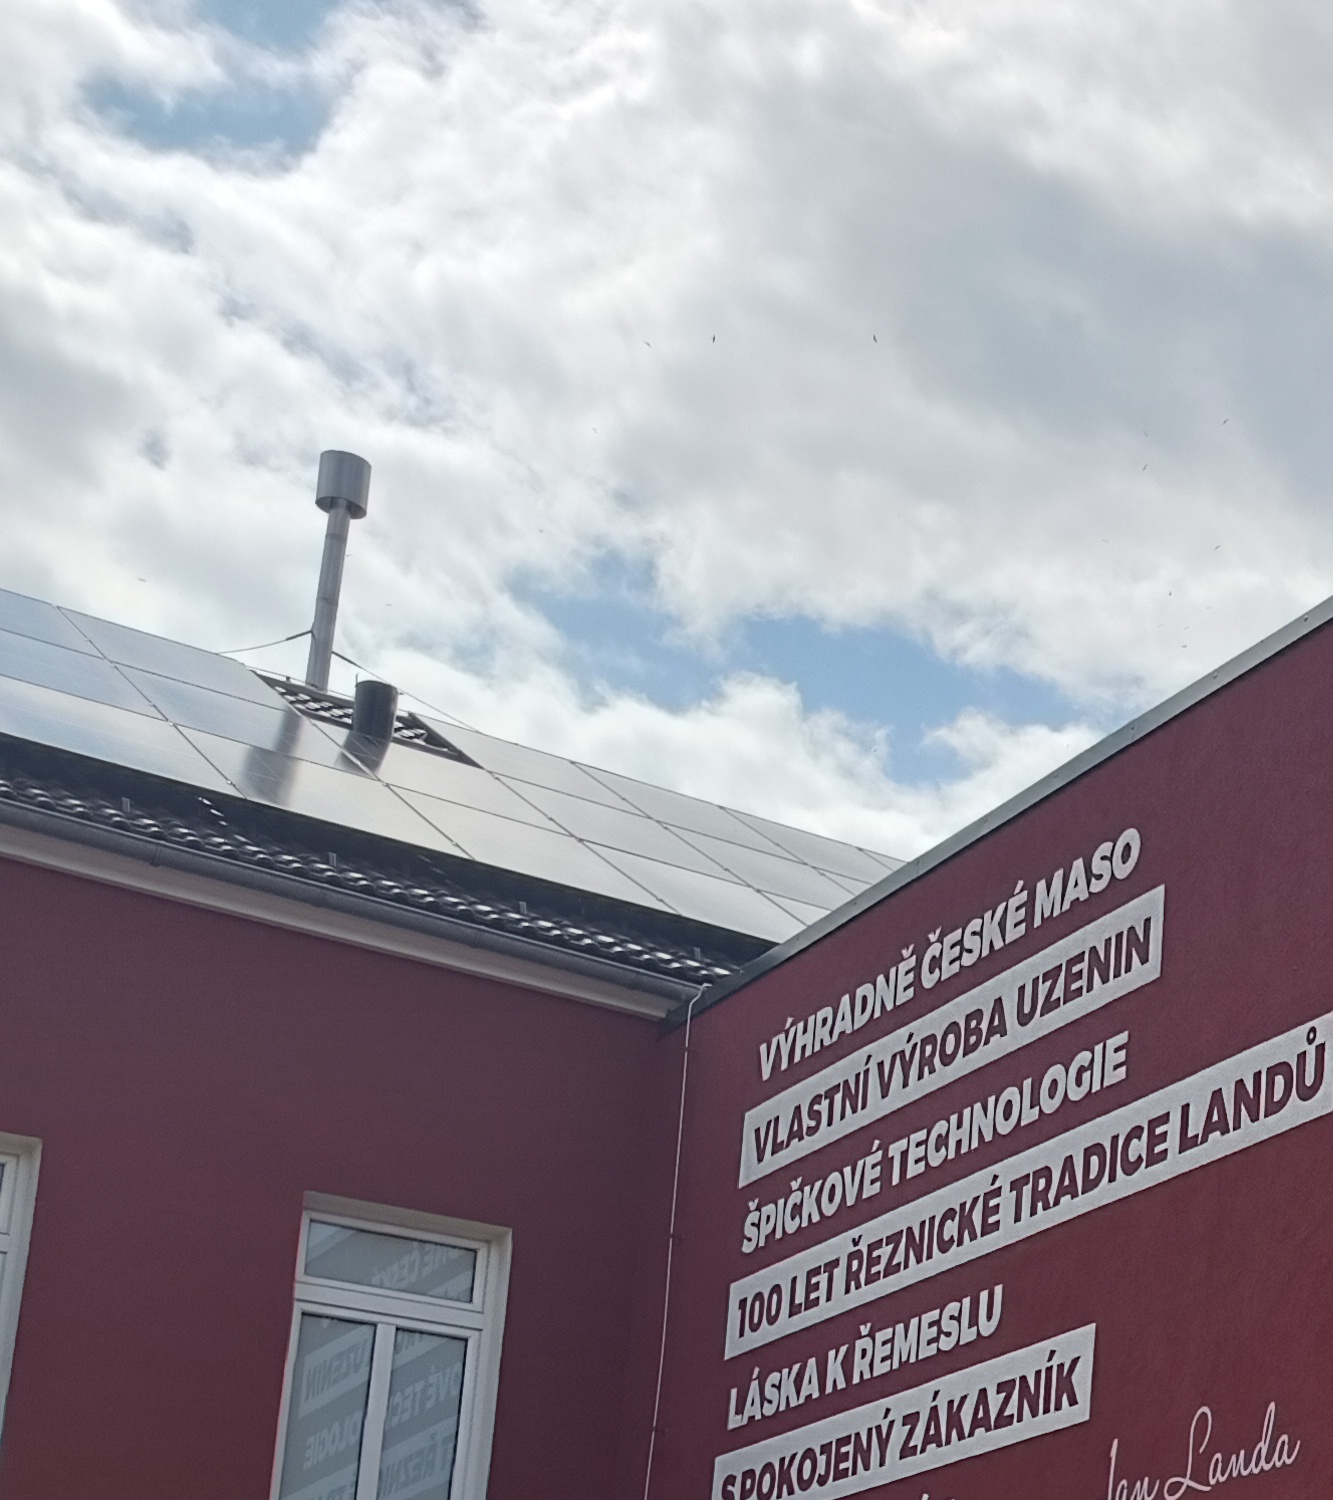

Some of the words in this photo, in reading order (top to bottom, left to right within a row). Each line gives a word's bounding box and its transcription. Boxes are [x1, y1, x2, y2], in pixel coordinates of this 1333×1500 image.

[752, 1055, 871, 1164] VLASTNÍ
[876, 996, 1008, 1099] VÝROBA
[1015, 916, 1153, 1028] UZENIN
[758, 943, 917, 1081] VÝHRADNĚ
[920, 880, 1027, 989] ČESKÉ
[1033, 827, 1142, 929] MASO
[737, 1284, 783, 1340] 100
[787, 1259, 841, 1319] LET
[843, 1176, 1003, 1297] ŘEZNICKÉ
[1010, 1112, 1171, 1226] TRADICE
[1177, 1027, 1328, 1156] LANDŮ
[740, 1139, 884, 1254] ŠPIČKOVÉ
[888, 1030, 1130, 1186] TECHNOLOGIE
[727, 1357, 820, 1431] LÁSKA
[824, 1344, 851, 1395] K
[852, 1284, 1004, 1386] ŘEMESLU
[899, 1349, 1083, 1461] ZÁKAZNÍK
